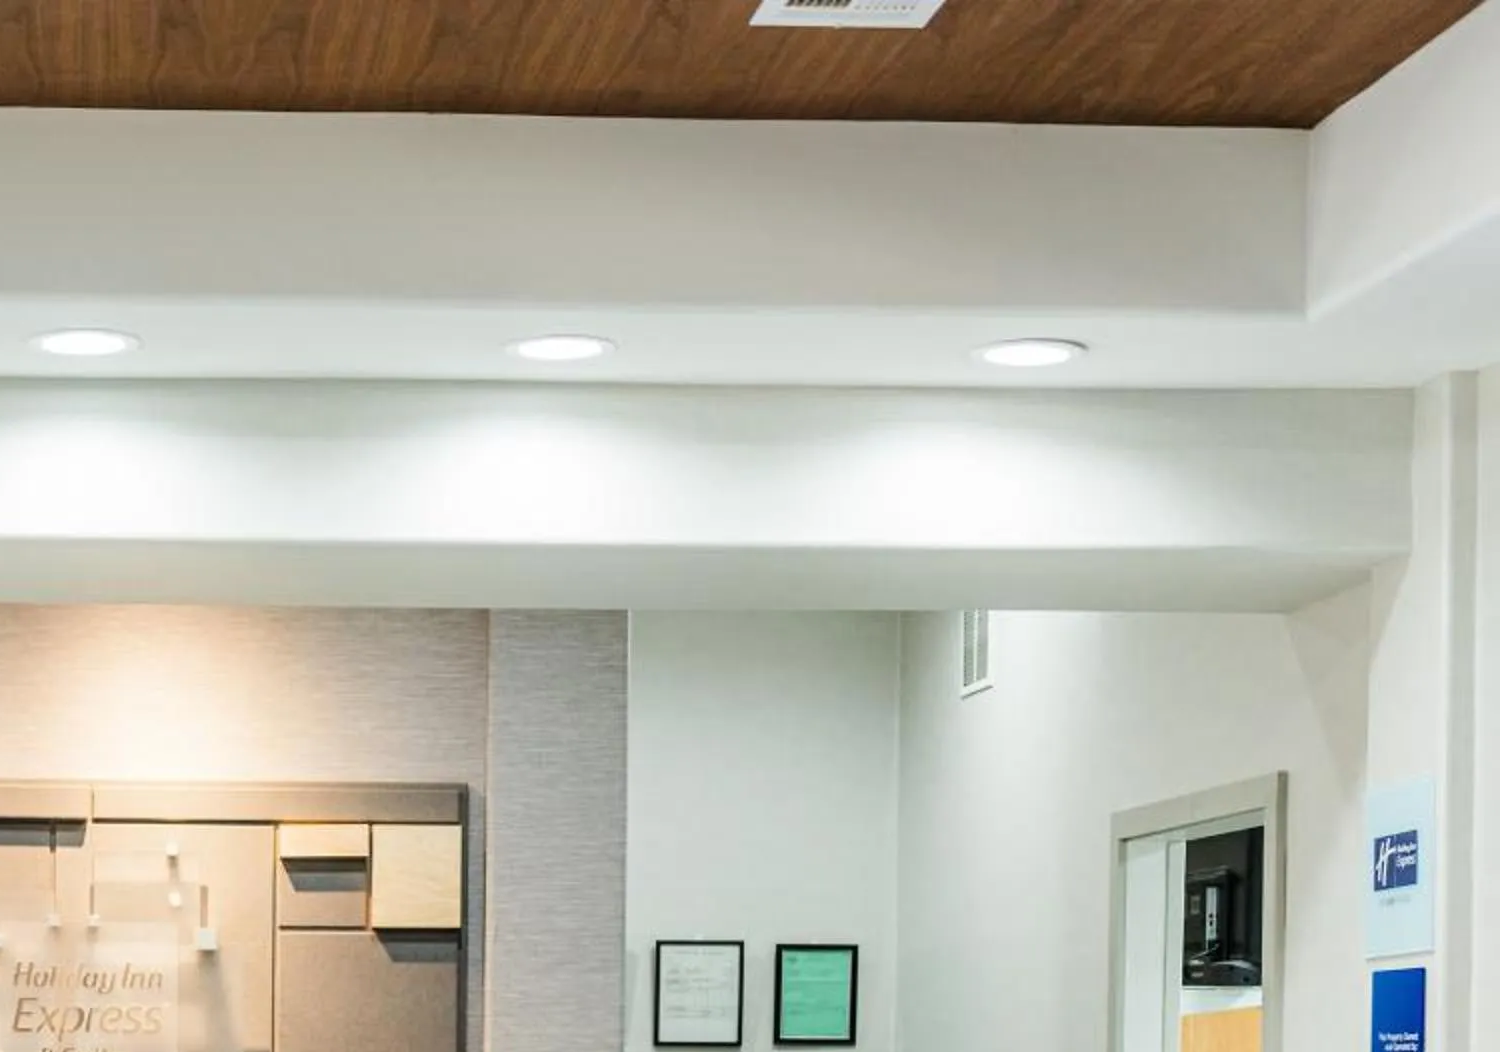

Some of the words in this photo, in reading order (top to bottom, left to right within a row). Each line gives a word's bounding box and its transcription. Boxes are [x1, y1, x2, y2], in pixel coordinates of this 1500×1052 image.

[13, 961, 116, 994] Holday
[121, 963, 163, 989] Inn
[12, 997, 163, 1042] Express
